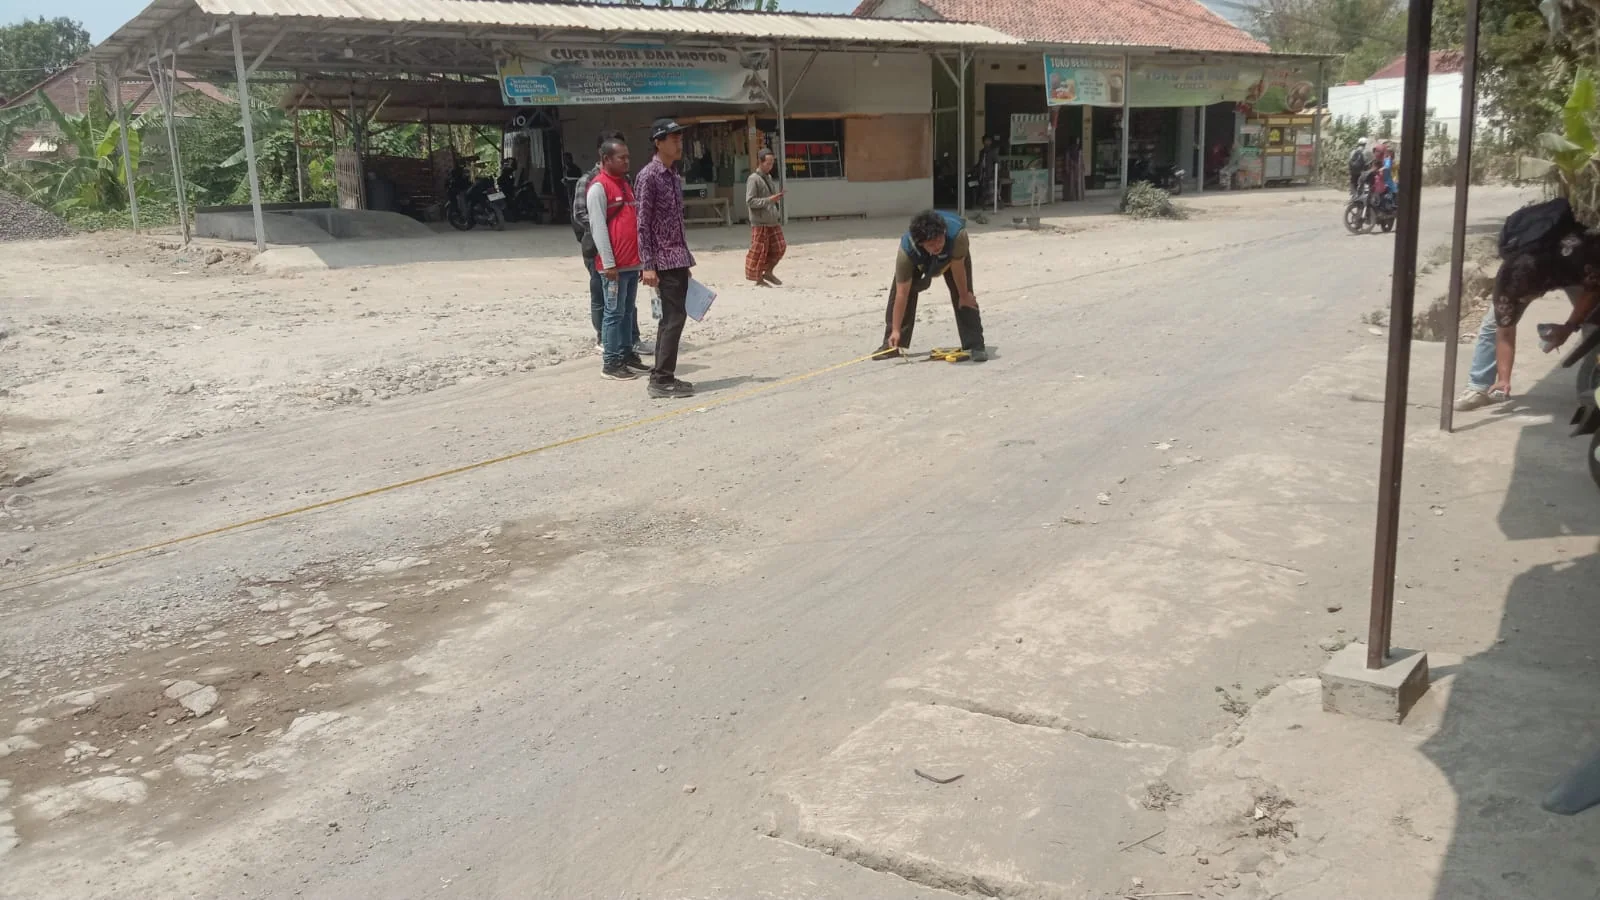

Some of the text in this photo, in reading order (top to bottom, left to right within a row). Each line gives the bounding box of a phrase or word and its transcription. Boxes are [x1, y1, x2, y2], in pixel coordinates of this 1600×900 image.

[550, 48, 589, 60] CUCI
[591, 48, 640, 61] MOBIL
[676, 50, 729, 64] MOTOR
